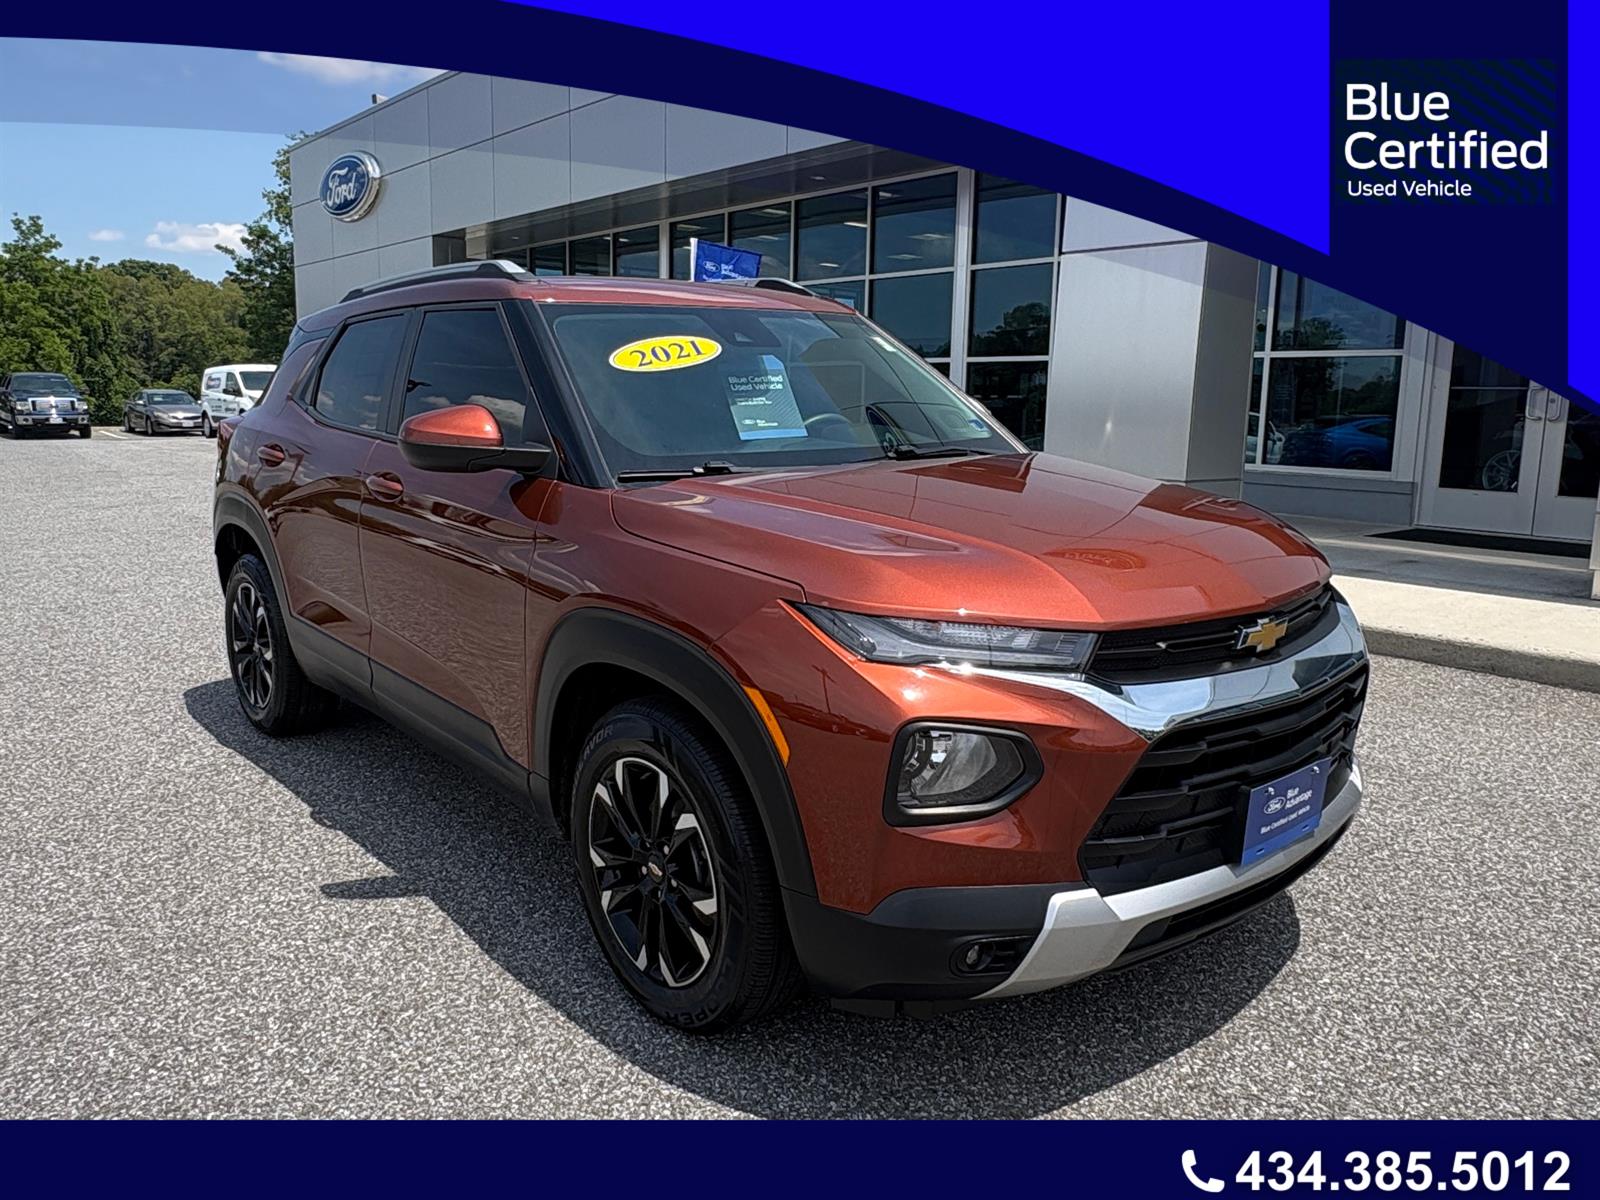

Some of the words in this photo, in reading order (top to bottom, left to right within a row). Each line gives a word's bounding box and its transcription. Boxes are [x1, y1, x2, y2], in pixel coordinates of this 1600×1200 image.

[327, 167, 357, 207] Ford
[629, 340, 706, 368] 2021
[728, 376, 748, 384] Blue
[748, 375, 783, 384] Certified
